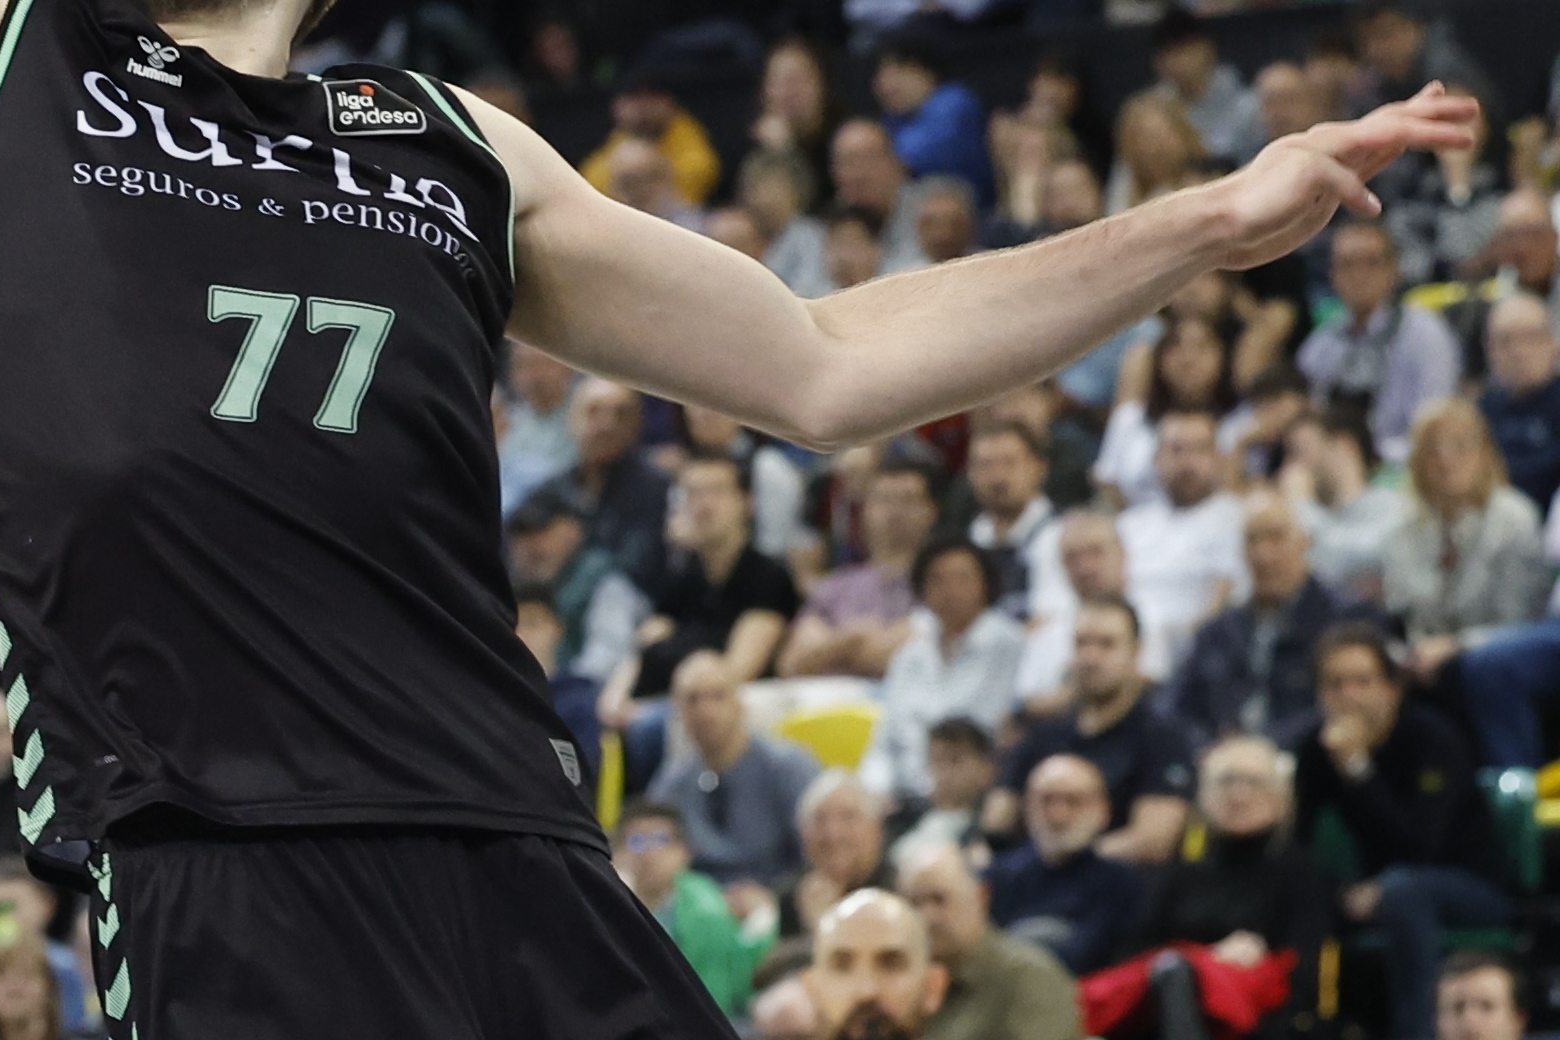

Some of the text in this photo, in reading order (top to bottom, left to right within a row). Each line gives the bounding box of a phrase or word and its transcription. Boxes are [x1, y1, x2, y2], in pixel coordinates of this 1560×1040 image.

[126, 57, 183, 88] hummel
[336, 91, 376, 110] liga
[339, 108, 419, 126] endesa
[72, 162, 242, 211] seguros
[257, 197, 285, 217] &
[207, 284, 396, 434] 77
